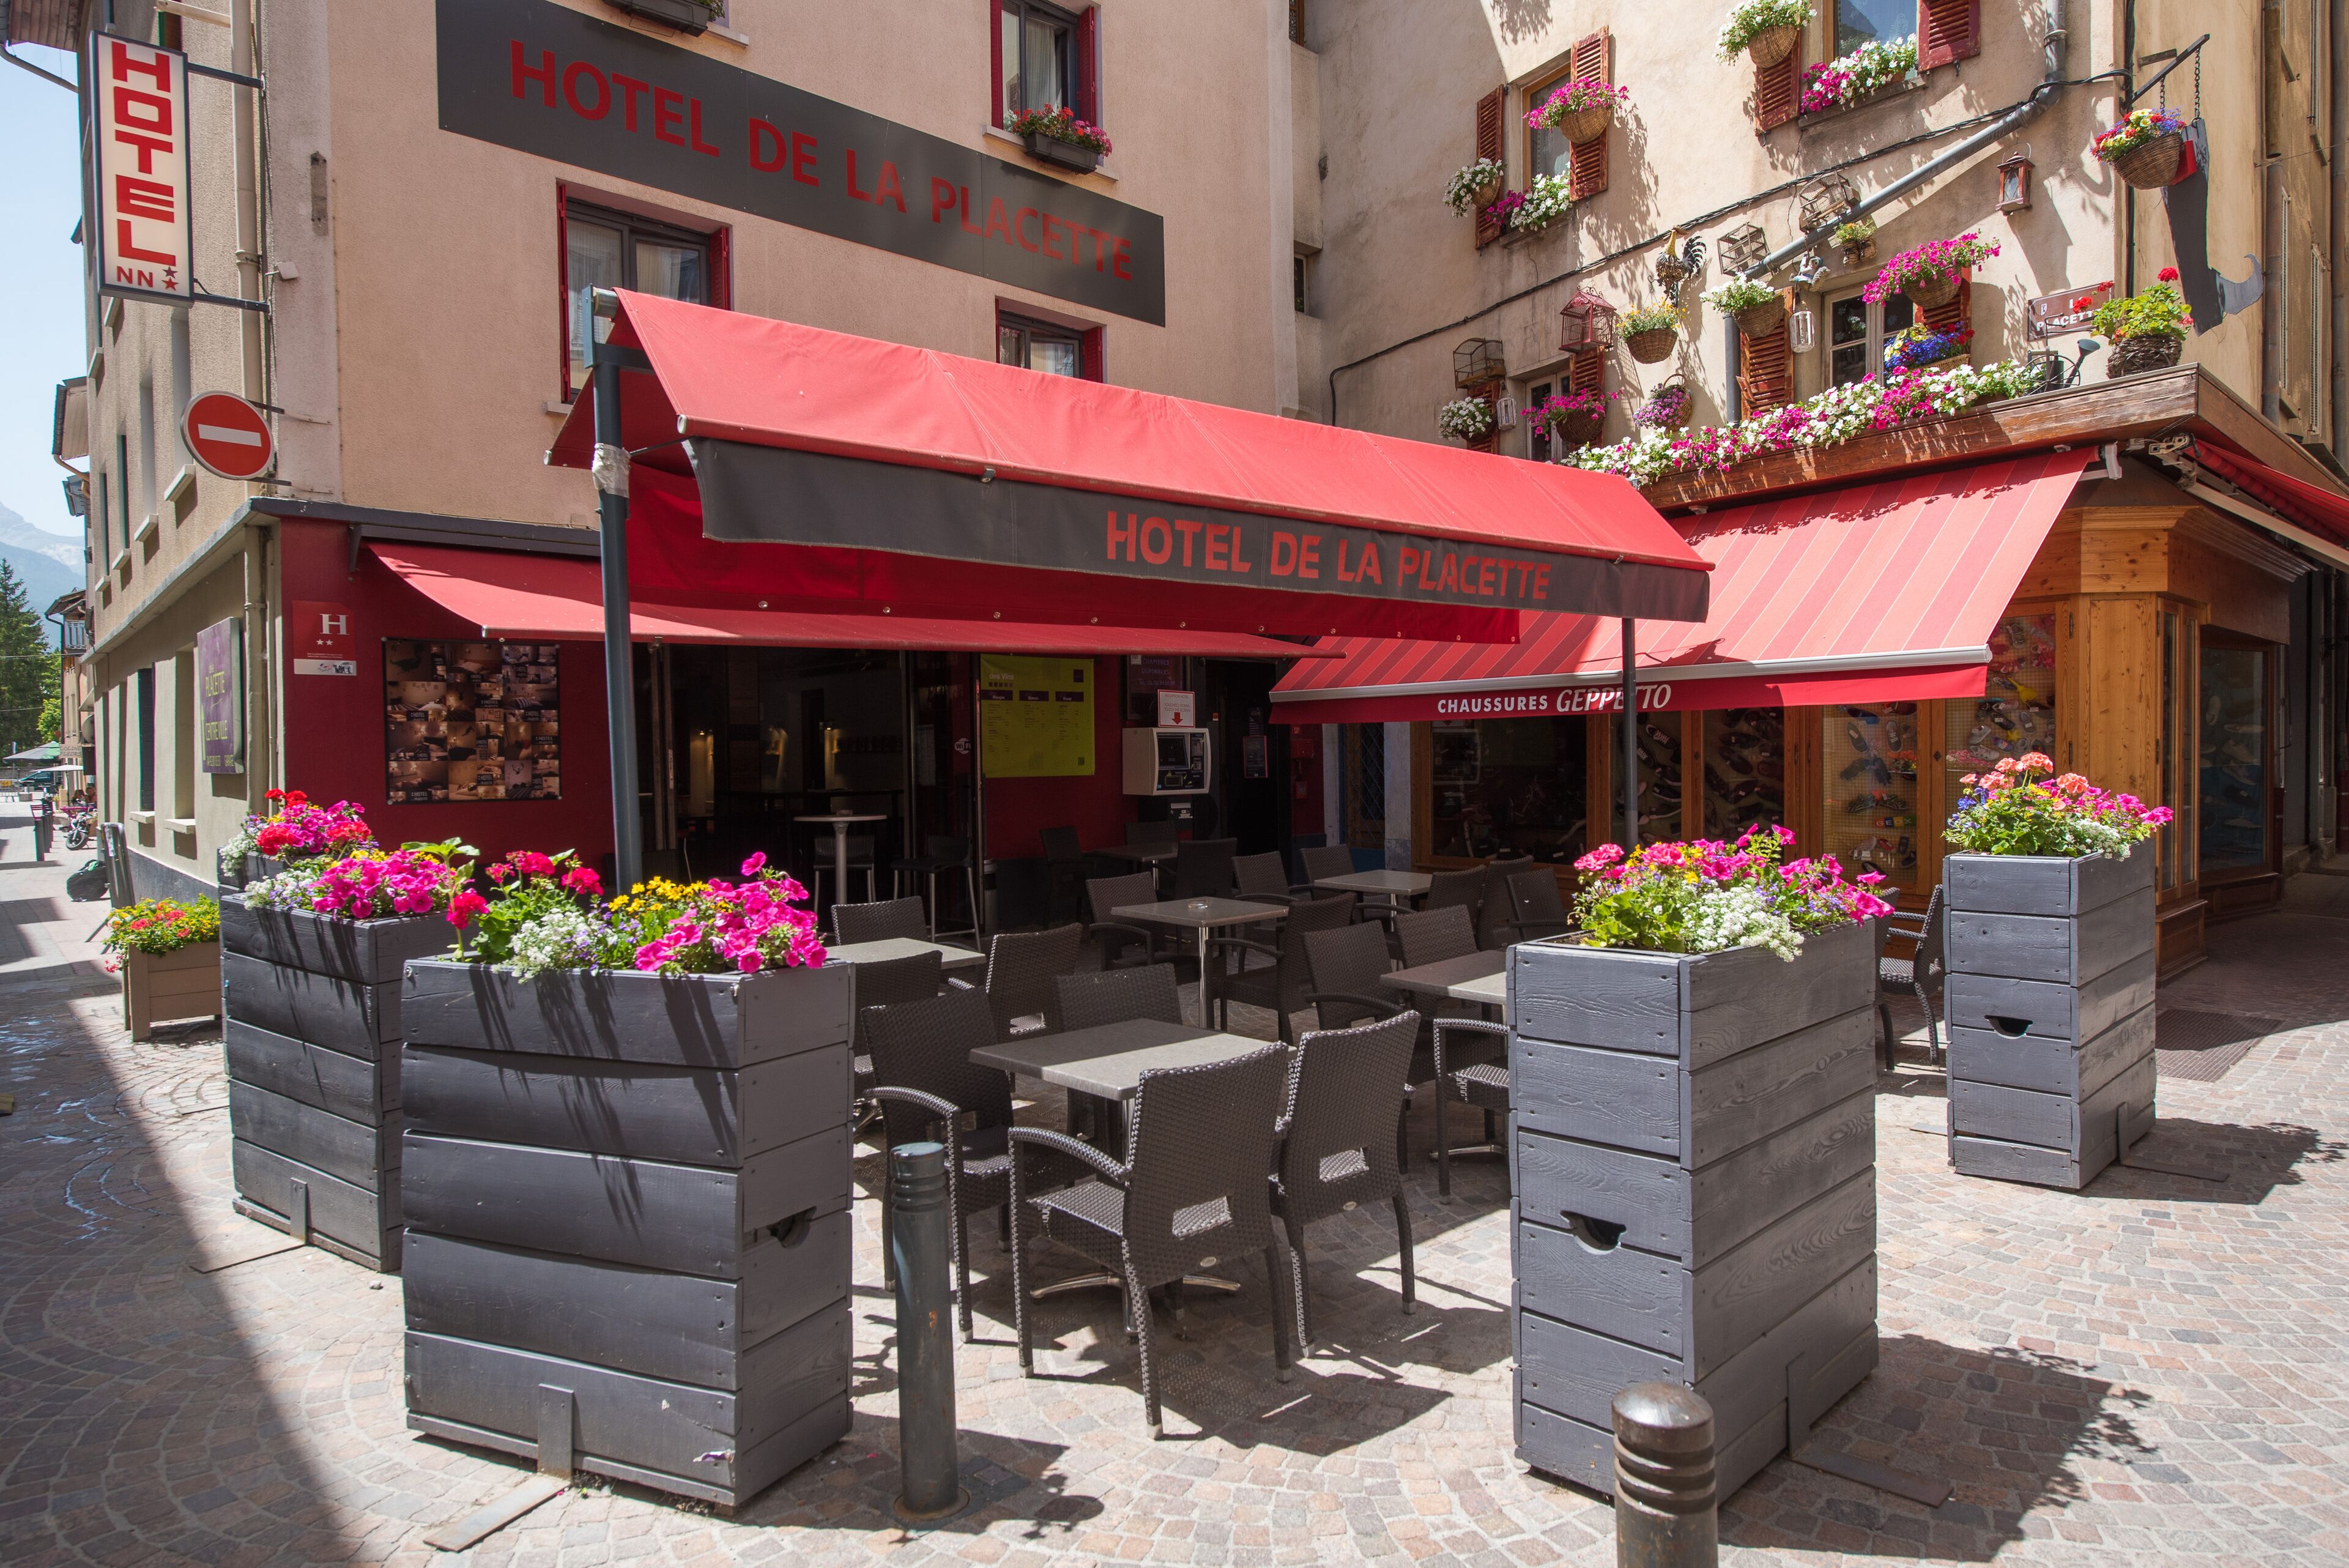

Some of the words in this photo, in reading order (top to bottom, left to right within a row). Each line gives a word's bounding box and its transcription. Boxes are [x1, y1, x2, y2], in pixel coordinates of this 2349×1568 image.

[111, 41, 177, 267] HOTEL
[510, 39, 720, 158] HOTEL
[748, 116, 820, 187] DE
[846, 149, 907, 214] LA
[930, 176, 1133, 281] PLACETTE
[116, 266, 154, 288] NN
[2036, 308, 2103, 332] PLACETT
[1106, 511, 1252, 573] HOTEL
[1270, 530, 1321, 579] DE
[1337, 538, 1382, 585] LA
[1398, 546, 1553, 600] PLACETTE
[319, 613, 349, 635] H
[206, 671, 225, 697] PLACETTE
[1438, 695, 1548, 713] CHAUSSURES
[1556, 684, 1671, 712] GEPPETO
[1876, 818, 1912, 827] GEOX
